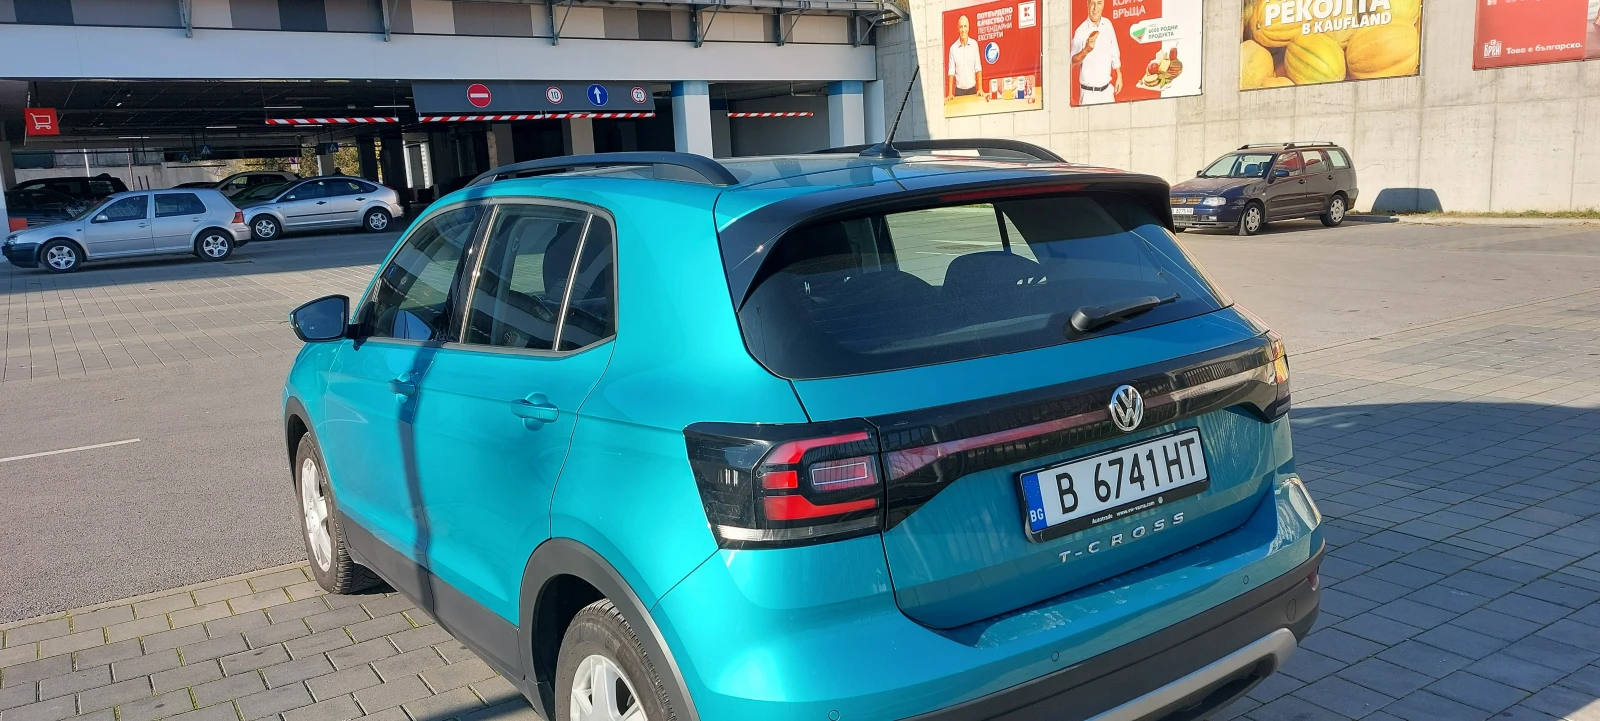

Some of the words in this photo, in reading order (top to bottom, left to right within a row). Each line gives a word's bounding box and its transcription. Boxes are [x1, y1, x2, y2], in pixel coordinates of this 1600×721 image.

[1112, 5, 1146, 19] ВРЪЩА
[1160, 24, 1178, 32] РОДНИ
[1314, 12, 1392, 33] KAUFLAND
[1148, 31, 1174, 39] ПРОДУКТА
[1535, 42, 1583, 52] българско.
[550, 91, 559, 100] 10
[1056, 472, 1078, 514] B
[1030, 509, 1044, 523] BG
[1092, 513, 1113, 524] Autotrade
[1059, 512, 1184, 562] T-CROSS
